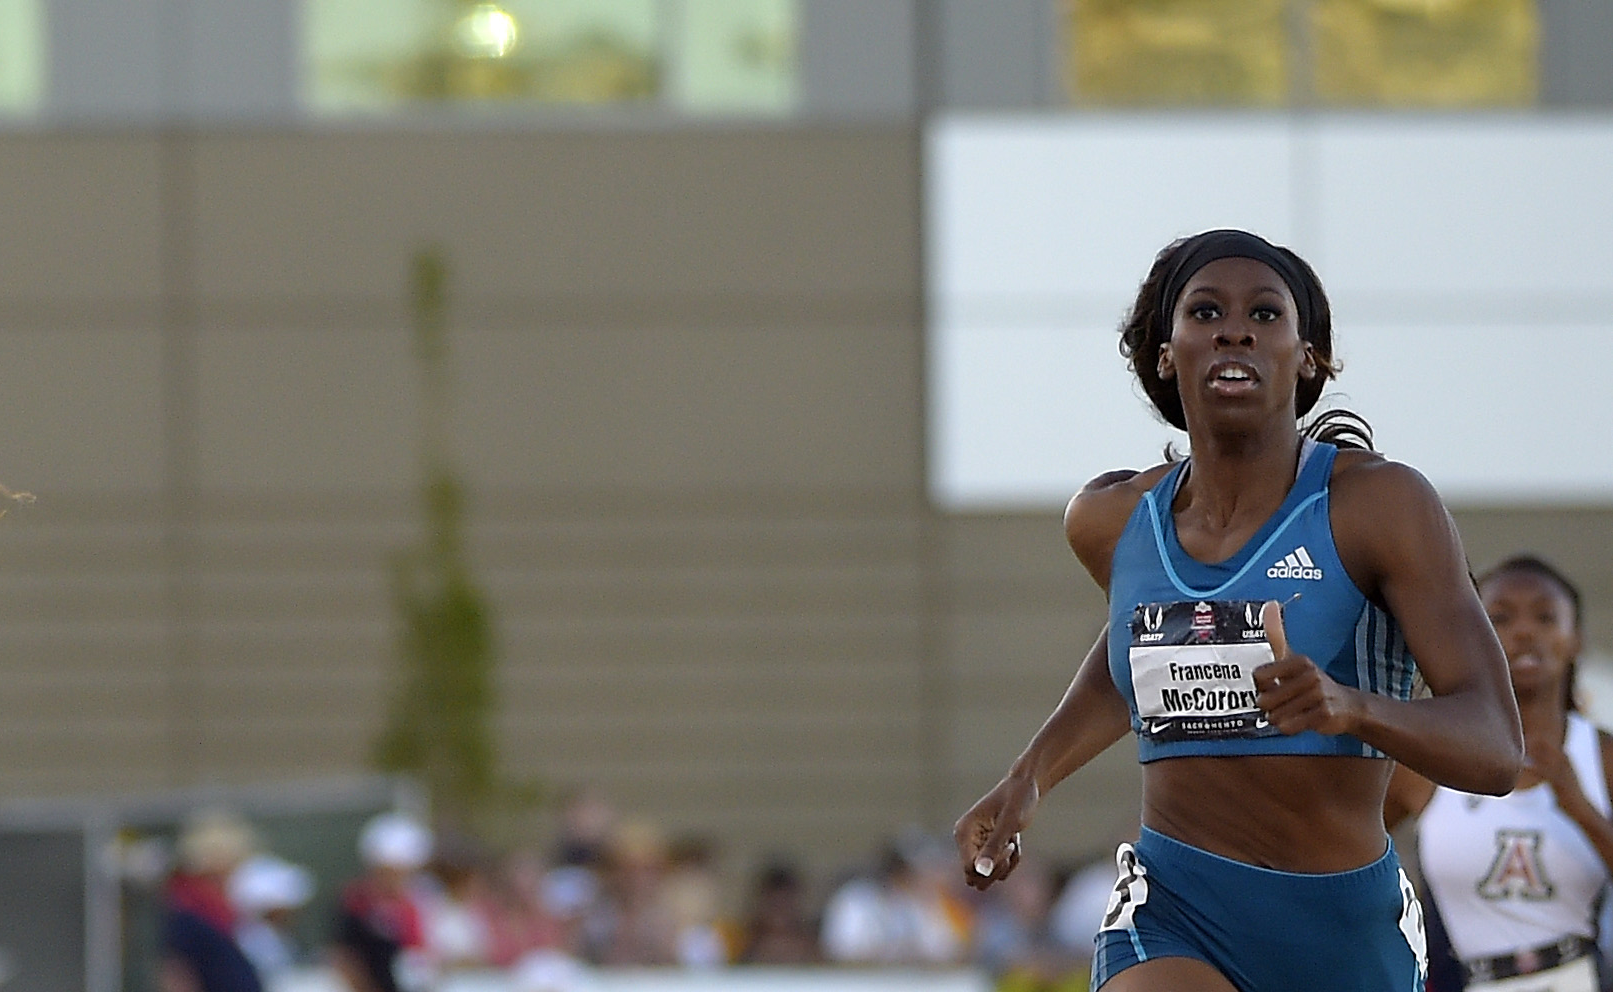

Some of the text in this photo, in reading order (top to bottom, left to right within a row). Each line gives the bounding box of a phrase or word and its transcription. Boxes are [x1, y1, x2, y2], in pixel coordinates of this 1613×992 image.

[1267, 565, 1323, 580] adidas
[1241, 629, 1267, 639] USAT
[1169, 661, 1242, 682] Francena
[1161, 687, 1259, 712] McCorory
[1475, 828, 1555, 902] A
